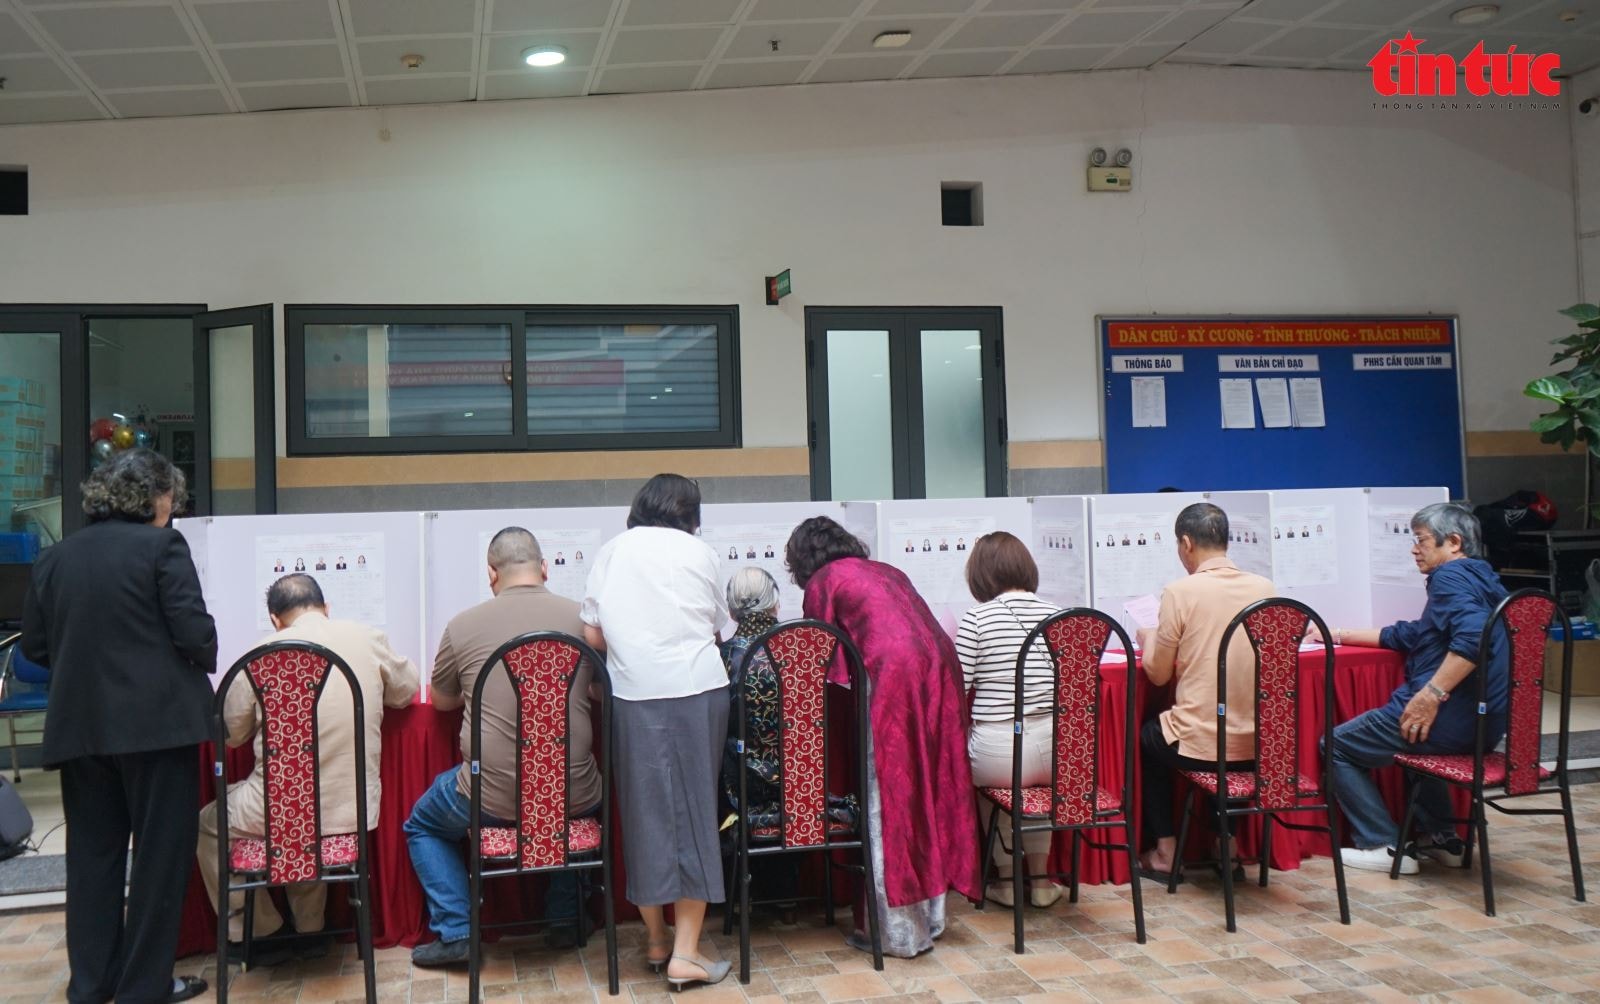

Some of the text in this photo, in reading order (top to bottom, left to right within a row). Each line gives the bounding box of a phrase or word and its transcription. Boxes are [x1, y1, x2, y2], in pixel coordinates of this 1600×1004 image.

[1118, 326, 1148, 343] DÂN
[1151, 326, 1178, 343] CHỦ
[1209, 327, 1254, 343] CƯƠNG
[1263, 326, 1293, 343] TÌNH
[1296, 327, 1350, 343] THƯƠNG
[1359, 325, 1400, 342] TRÁCH
[1402, 325, 1441, 343] NHIỆM
[1124, 357, 1172, 369] THÔNG BÁO
[1235, 357, 1252, 369] VĂN
[1253, 355, 1270, 369] BẢN
[1287, 358, 1304, 370] ĐẠO
[1363, 357, 1385, 367] PHHS
[1403, 356, 1425, 367] QUAN
[1426, 354, 1443, 366] TÂM
